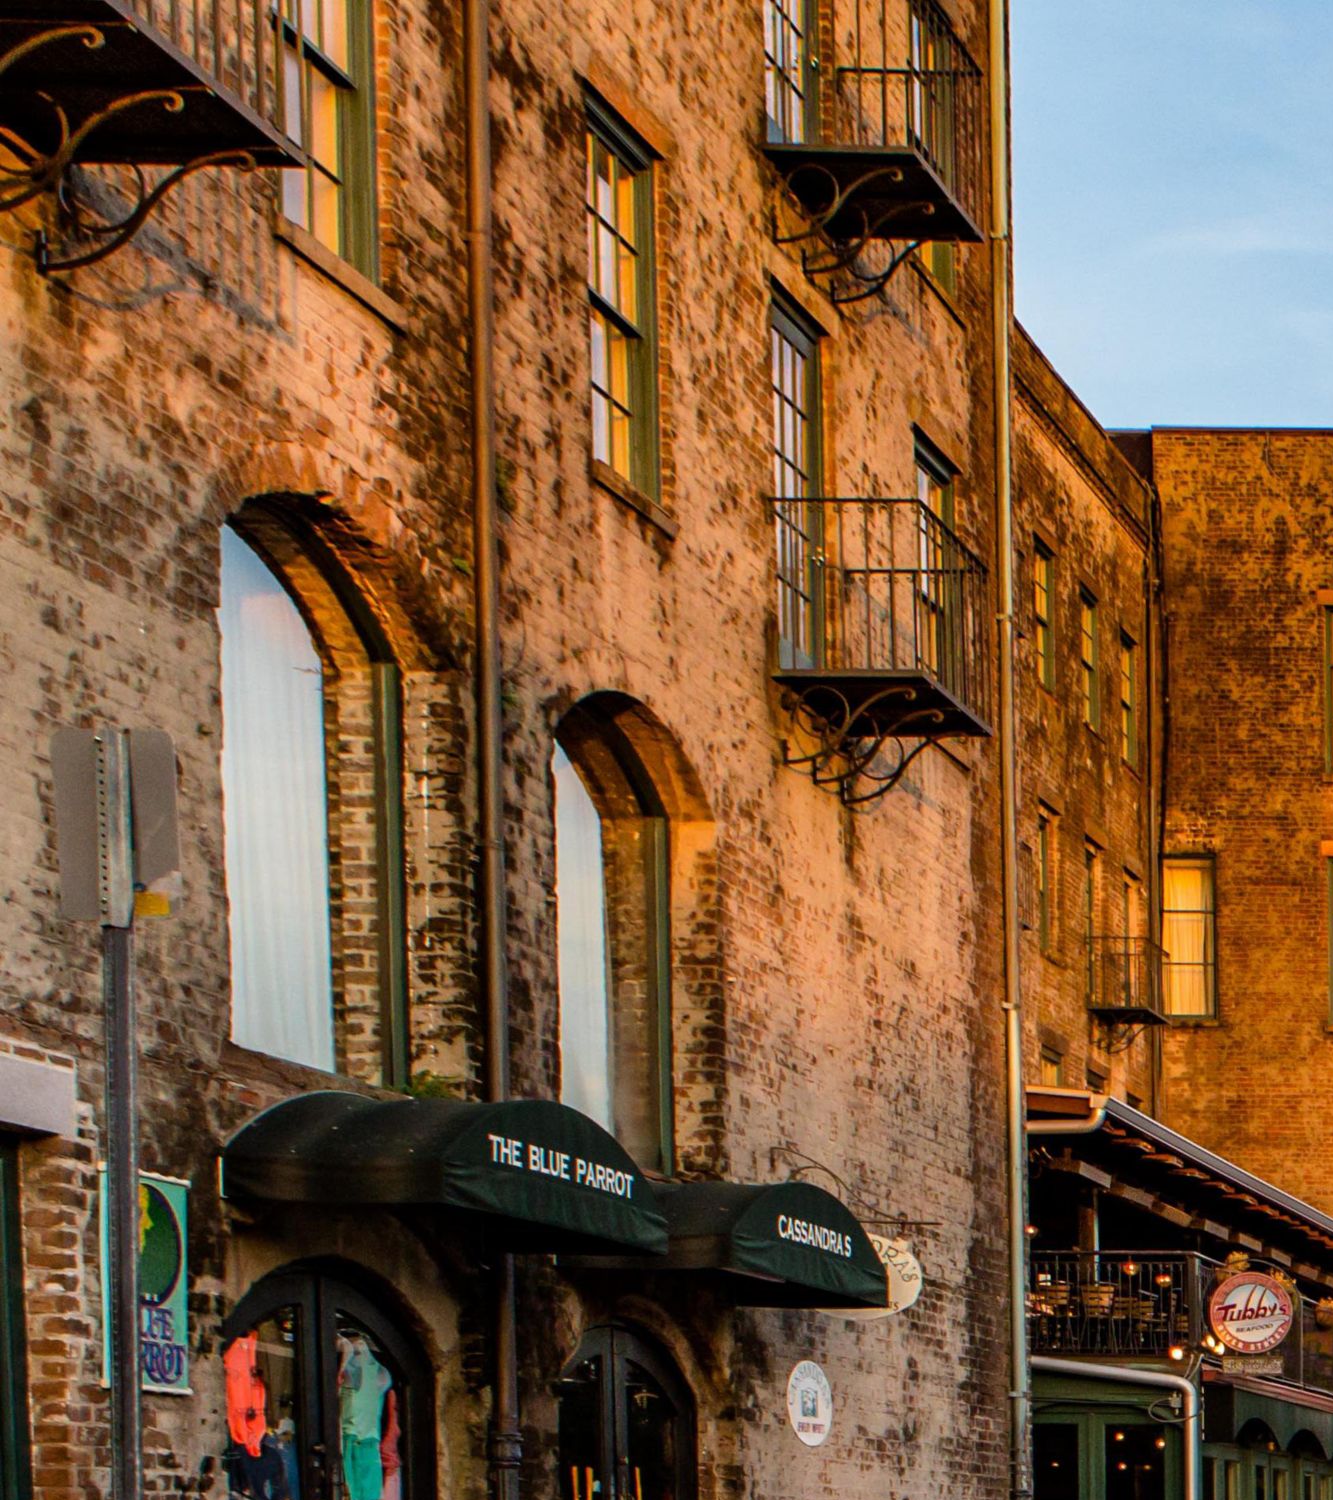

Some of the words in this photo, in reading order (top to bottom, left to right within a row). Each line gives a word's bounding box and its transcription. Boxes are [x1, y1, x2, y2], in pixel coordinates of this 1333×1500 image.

[488, 1133, 523, 1168] THE
[528, 1144, 571, 1181] BLUE
[575, 1158, 635, 1199] PARROT
